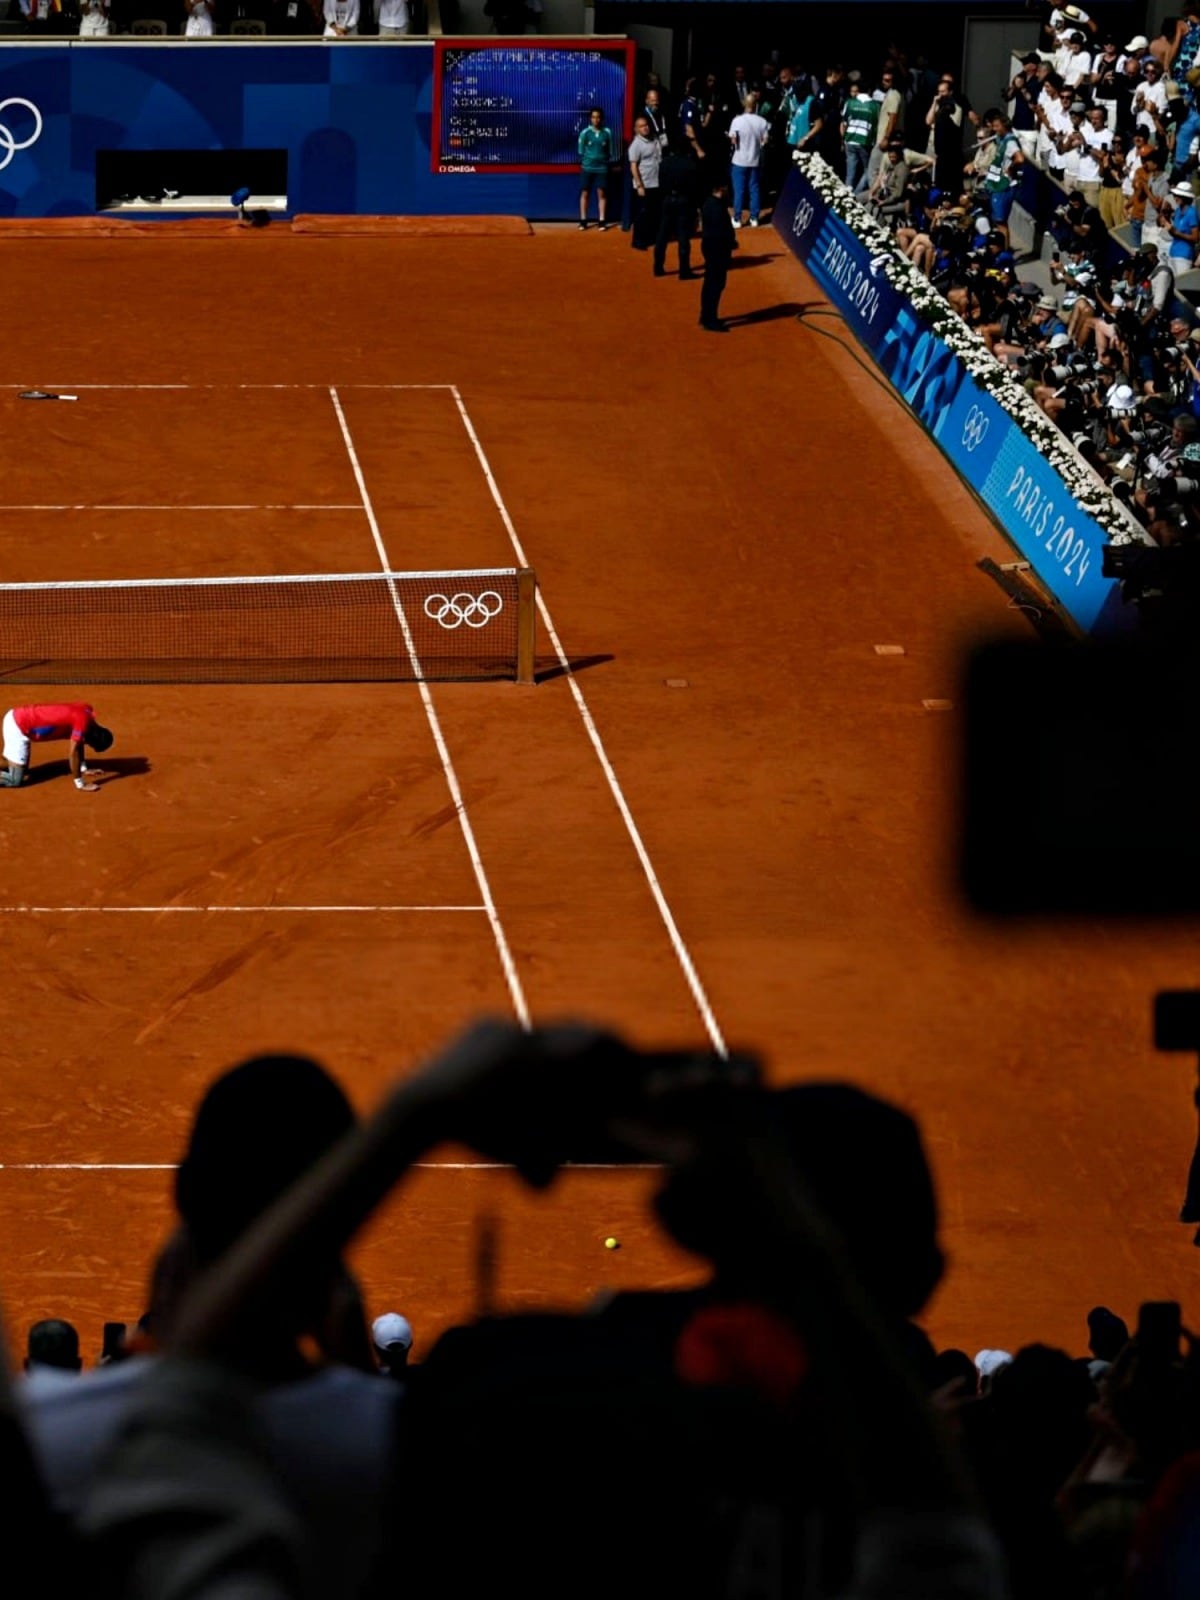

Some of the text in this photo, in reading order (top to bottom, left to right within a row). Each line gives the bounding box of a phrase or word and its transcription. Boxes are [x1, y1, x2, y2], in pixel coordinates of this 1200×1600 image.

[448, 165, 476, 173] OMEGA
[847, 271, 880, 325] 2024
[1045, 515, 1091, 587] 2024
